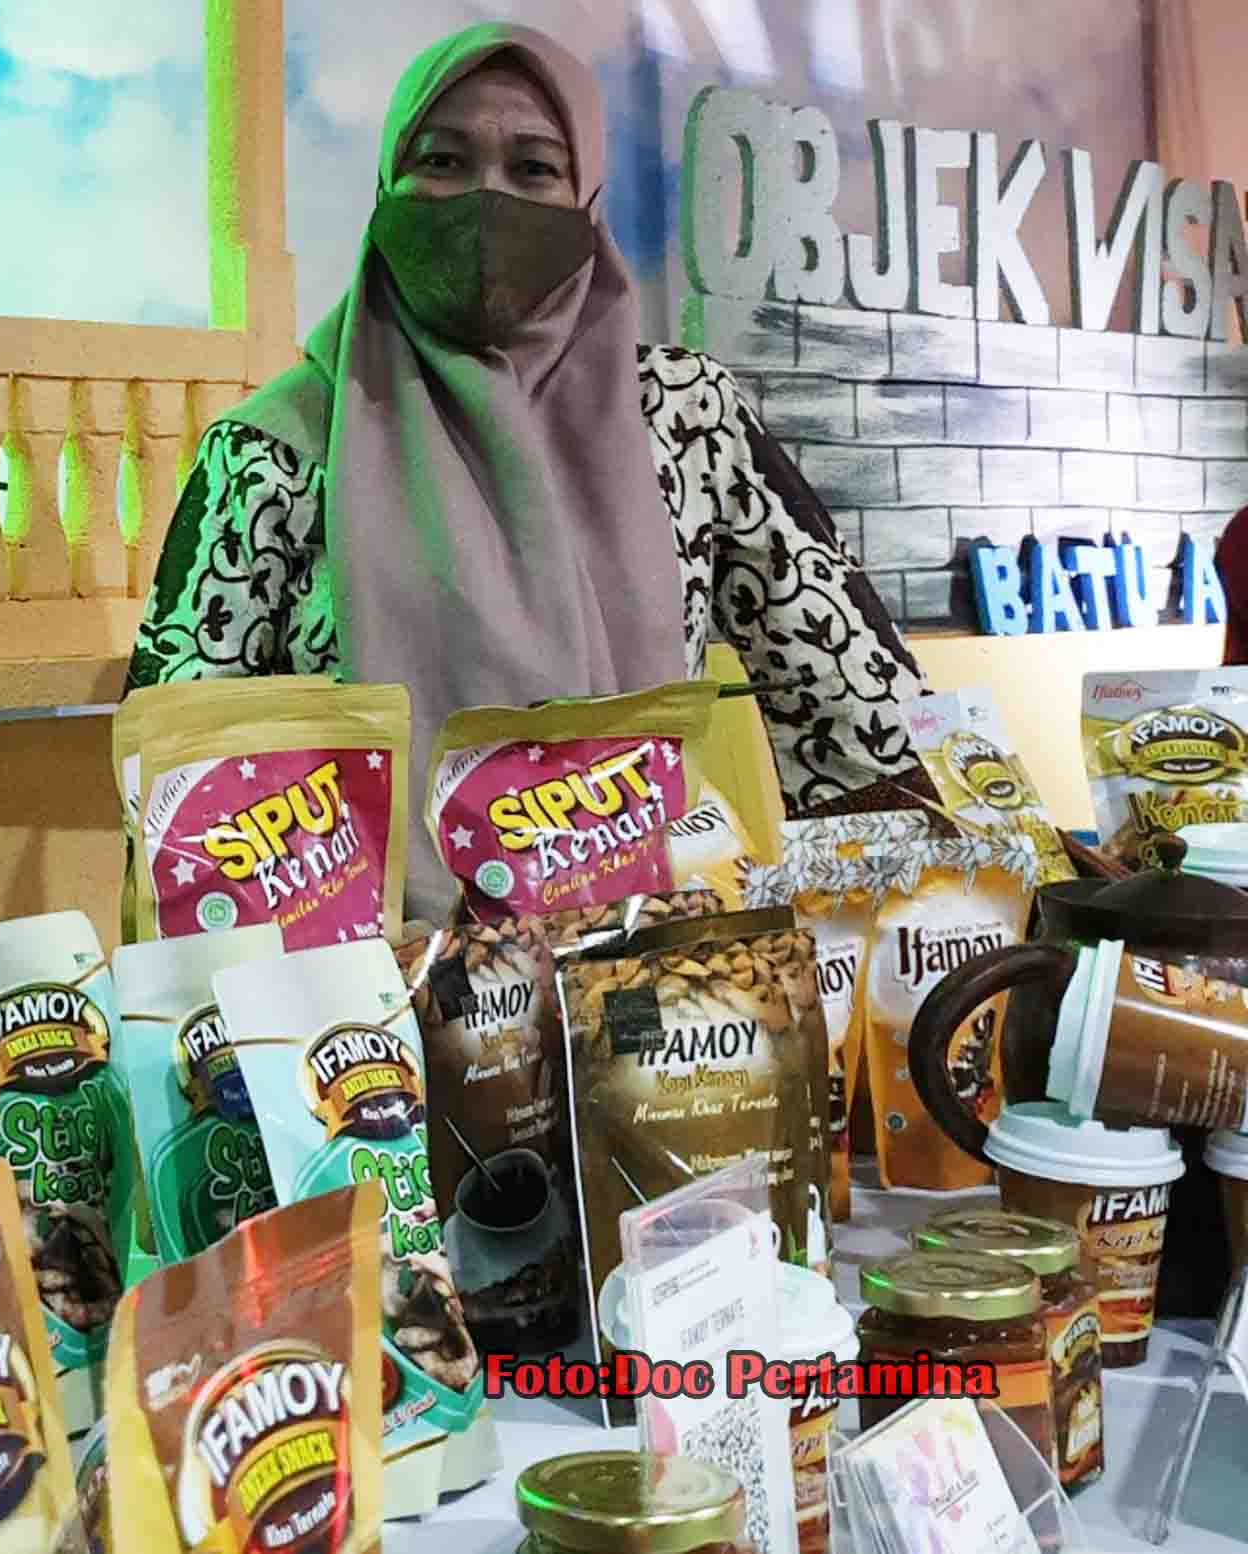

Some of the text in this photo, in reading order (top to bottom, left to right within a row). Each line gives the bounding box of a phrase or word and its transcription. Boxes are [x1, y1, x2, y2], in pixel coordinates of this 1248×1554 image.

[682, 85, 1051, 326] OBJEK
[1131, 715, 1226, 744] IFAMOY
[201, 759, 342, 882] SIPUT
[488, 744, 656, 852] SIPUT
[532, 798, 667, 881] Kenari
[254, 798, 361, 910] Kenari
[4, 991, 88, 1032] AMOY
[311, 1034, 401, 1085] IFAMOY
[691, 1096, 724, 1117] Khas
[198, 1361, 344, 1487] IFAMOY
[279, 1431, 337, 1475] SNACK
